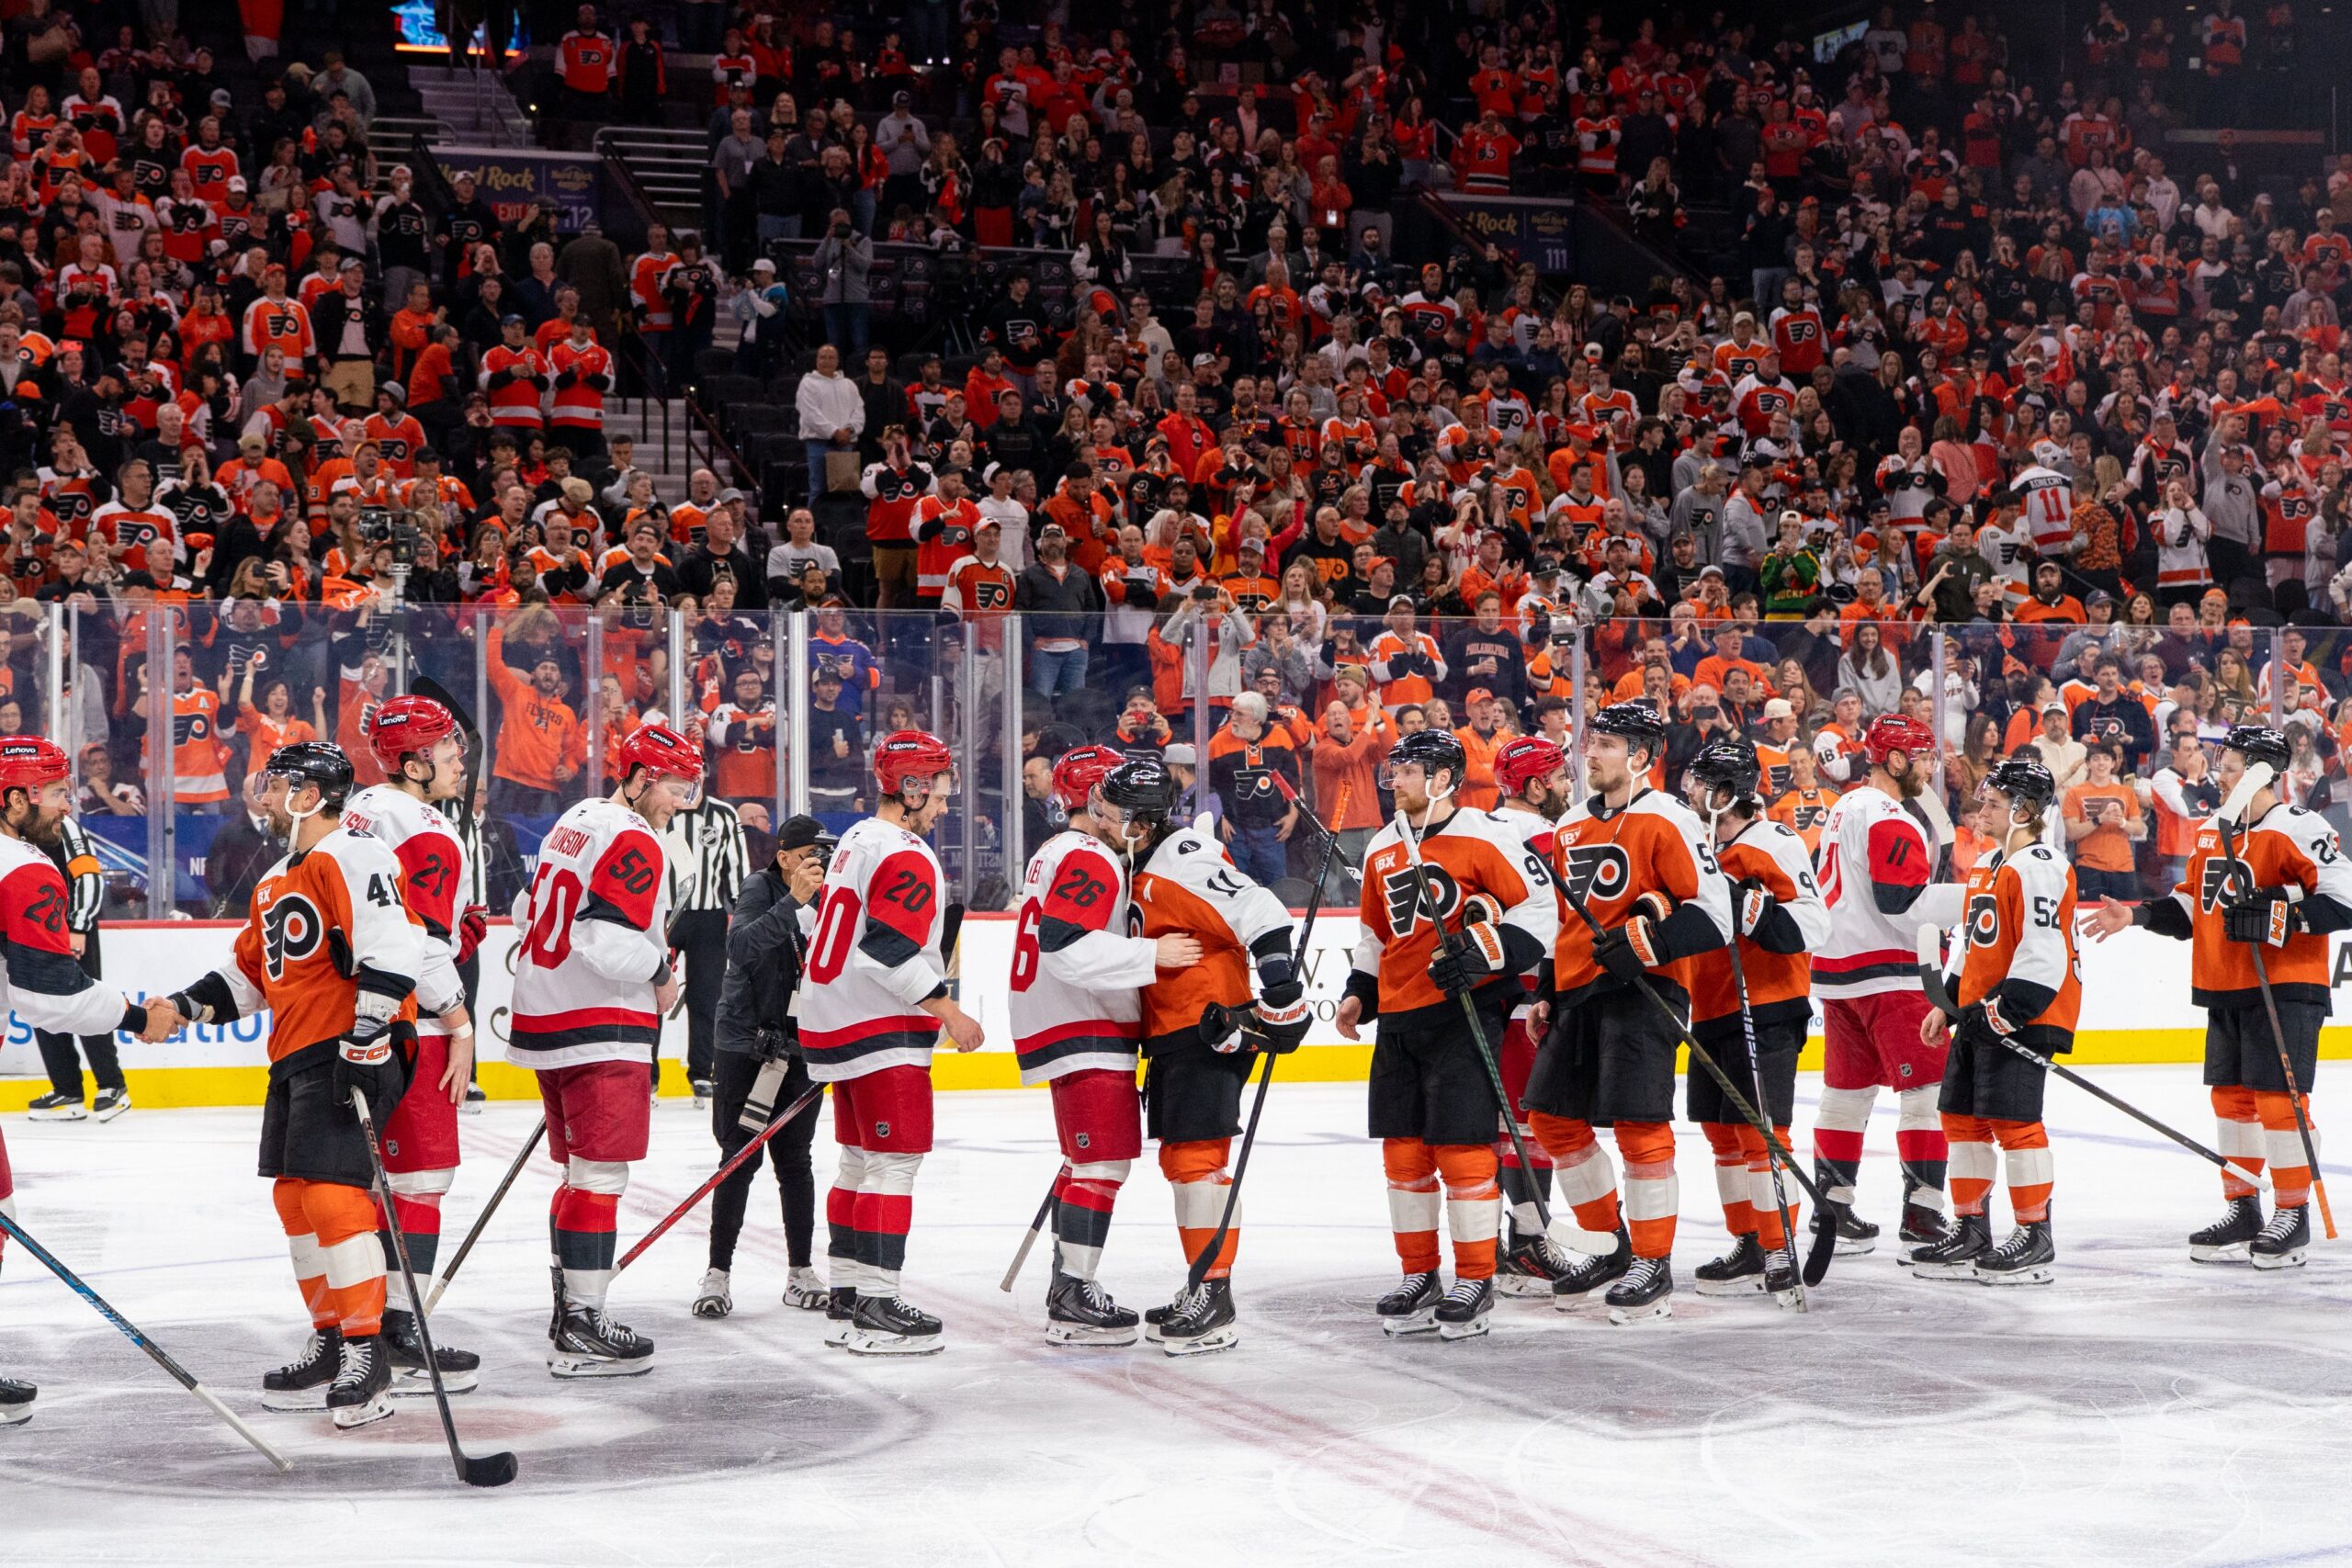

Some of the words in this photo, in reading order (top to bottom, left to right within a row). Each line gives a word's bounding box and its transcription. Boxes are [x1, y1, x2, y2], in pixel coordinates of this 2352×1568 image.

[487, 165, 535, 192] Rock
[498, 203, 525, 221] EXIT
[1546, 247, 1567, 270] 111
[2039, 488, 2066, 524] 11
[1464, 642, 1510, 660] PHILADELPHIA
[198, 696, 210, 710] A
[379, 714, 407, 727] Lenovo
[5, 746, 37, 755] Lenovo
[649, 730, 674, 748] Lenovo
[888, 741, 917, 750] Lenovo
[1510, 744, 1532, 758] Lenovo
[1069, 751, 1096, 761] Lenovo
[1886, 837, 1911, 867] 11
[2198, 837, 2218, 850] IBX
[410, 853, 451, 897] 21
[608, 848, 654, 896] 50
[1374, 854, 1396, 872] IBX
[368, 873, 404, 908] 41
[883, 870, 933, 913] 20
[1056, 868, 1106, 908] 26
[1206, 868, 1245, 898] 11
[23, 885, 66, 933] 28
[2033, 896, 2060, 930] 52
[2001, 1037, 2059, 1071] CCM
[2280, 1053, 2301, 1109] CCM
[364, 1119, 383, 1157] CCM
[1786, 1227, 1797, 1257] BAUER
[79, 1292, 142, 1348] BAUER
[887, 1314, 911, 1327] BAUER
[565, 1332, 593, 1354] CCM
